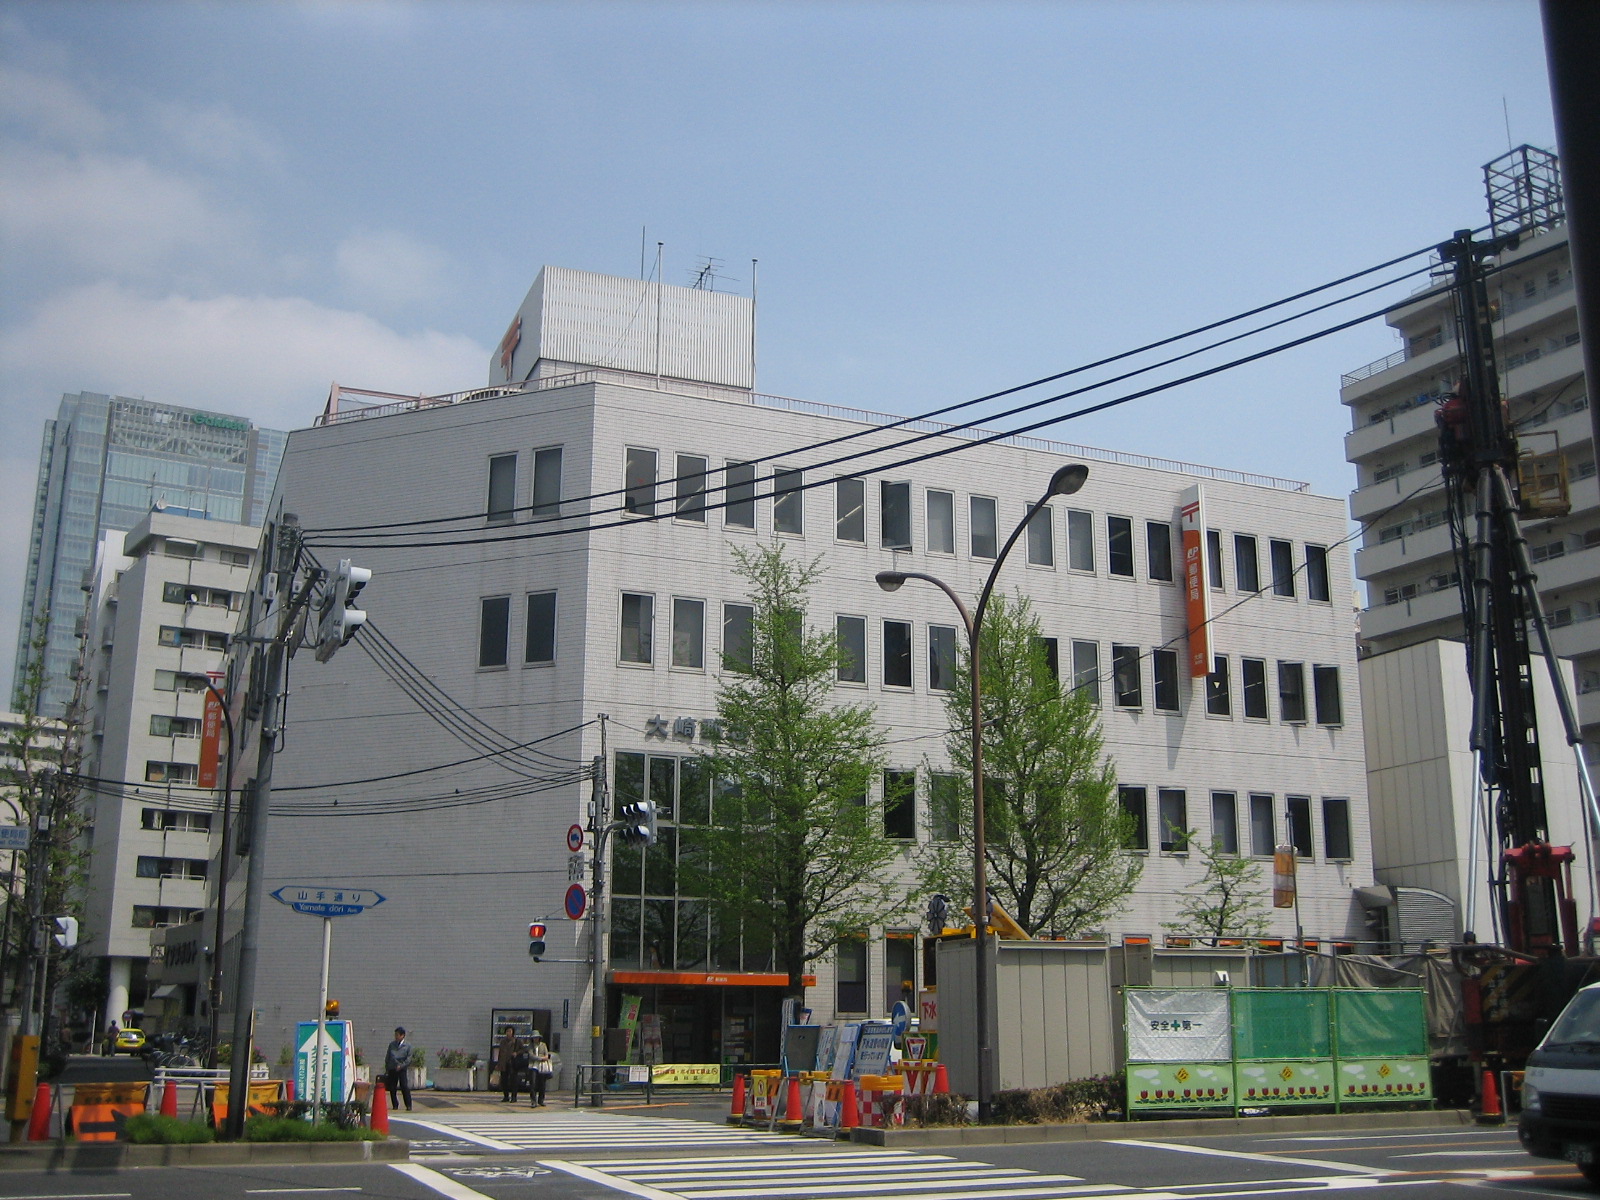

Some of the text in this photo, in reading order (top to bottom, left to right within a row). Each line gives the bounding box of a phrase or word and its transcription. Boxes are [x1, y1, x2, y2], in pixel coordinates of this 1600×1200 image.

[194, 413, 247, 431] Gakken
[1188, 563, 1199, 601] 郵便局
[206, 712, 217, 737] 郵便局
[298, 890, 361, 902] 山手通り
[299, 903, 325, 911] Yamate
